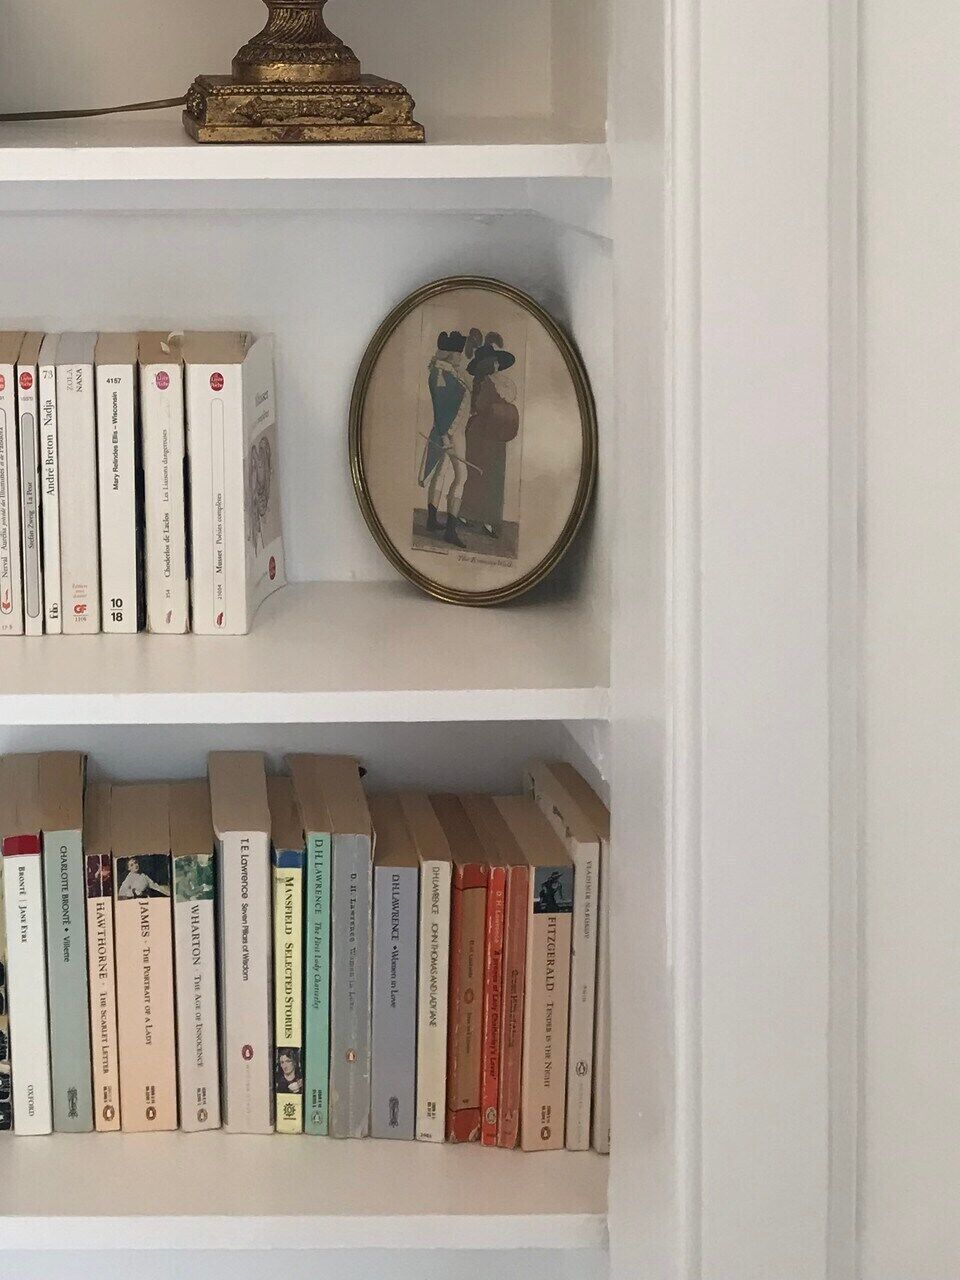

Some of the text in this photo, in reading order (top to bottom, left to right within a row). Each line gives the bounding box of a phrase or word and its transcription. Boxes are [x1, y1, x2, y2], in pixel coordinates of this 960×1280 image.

[66, 368, 74, 391] ZOLA
[42, 399, 56, 496] André Breton Nadja
[110, 391, 121, 490] Mary Relindes Ellis Wisconsin
[161, 466, 170, 490] Liaisons
[162, 512, 172, 578] Choderlos de Laclos
[1, 556, 9, 578] Nerval
[110, 598, 123, 608] 10
[110, 612, 123, 622] 18
[241, 845, 250, 853] E.
[240, 854, 250, 899] Lawrence
[584, 860, 593, 900] VLADIMIR
[59, 845, 71, 963] CHARLOTTE BRONTË Villette
[241, 902, 249, 925] Seven
[139, 901, 150, 937] JAMES
[96, 902, 108, 979] HAWTHORNE
[241, 925, 250, 944] Pillars
[242, 944, 249, 952] of
[143, 947, 151, 962] THE
[242, 953, 250, 981] Wisdom
[284, 876, 295, 1039] MANSFIELD SELECTED STORIES
[143, 964, 152, 1003] PORTRAIT
[189, 904, 204, 1068] WHARTON THE AGE OF INNOCENCE
[144, 1005, 152, 1015] OF
[100, 1010, 108, 1043] SCARLET
[145, 1024, 153, 1046] LADY
[102, 1045, 110, 1074] LETTER
[27, 1084, 35, 1116] OXFORD
